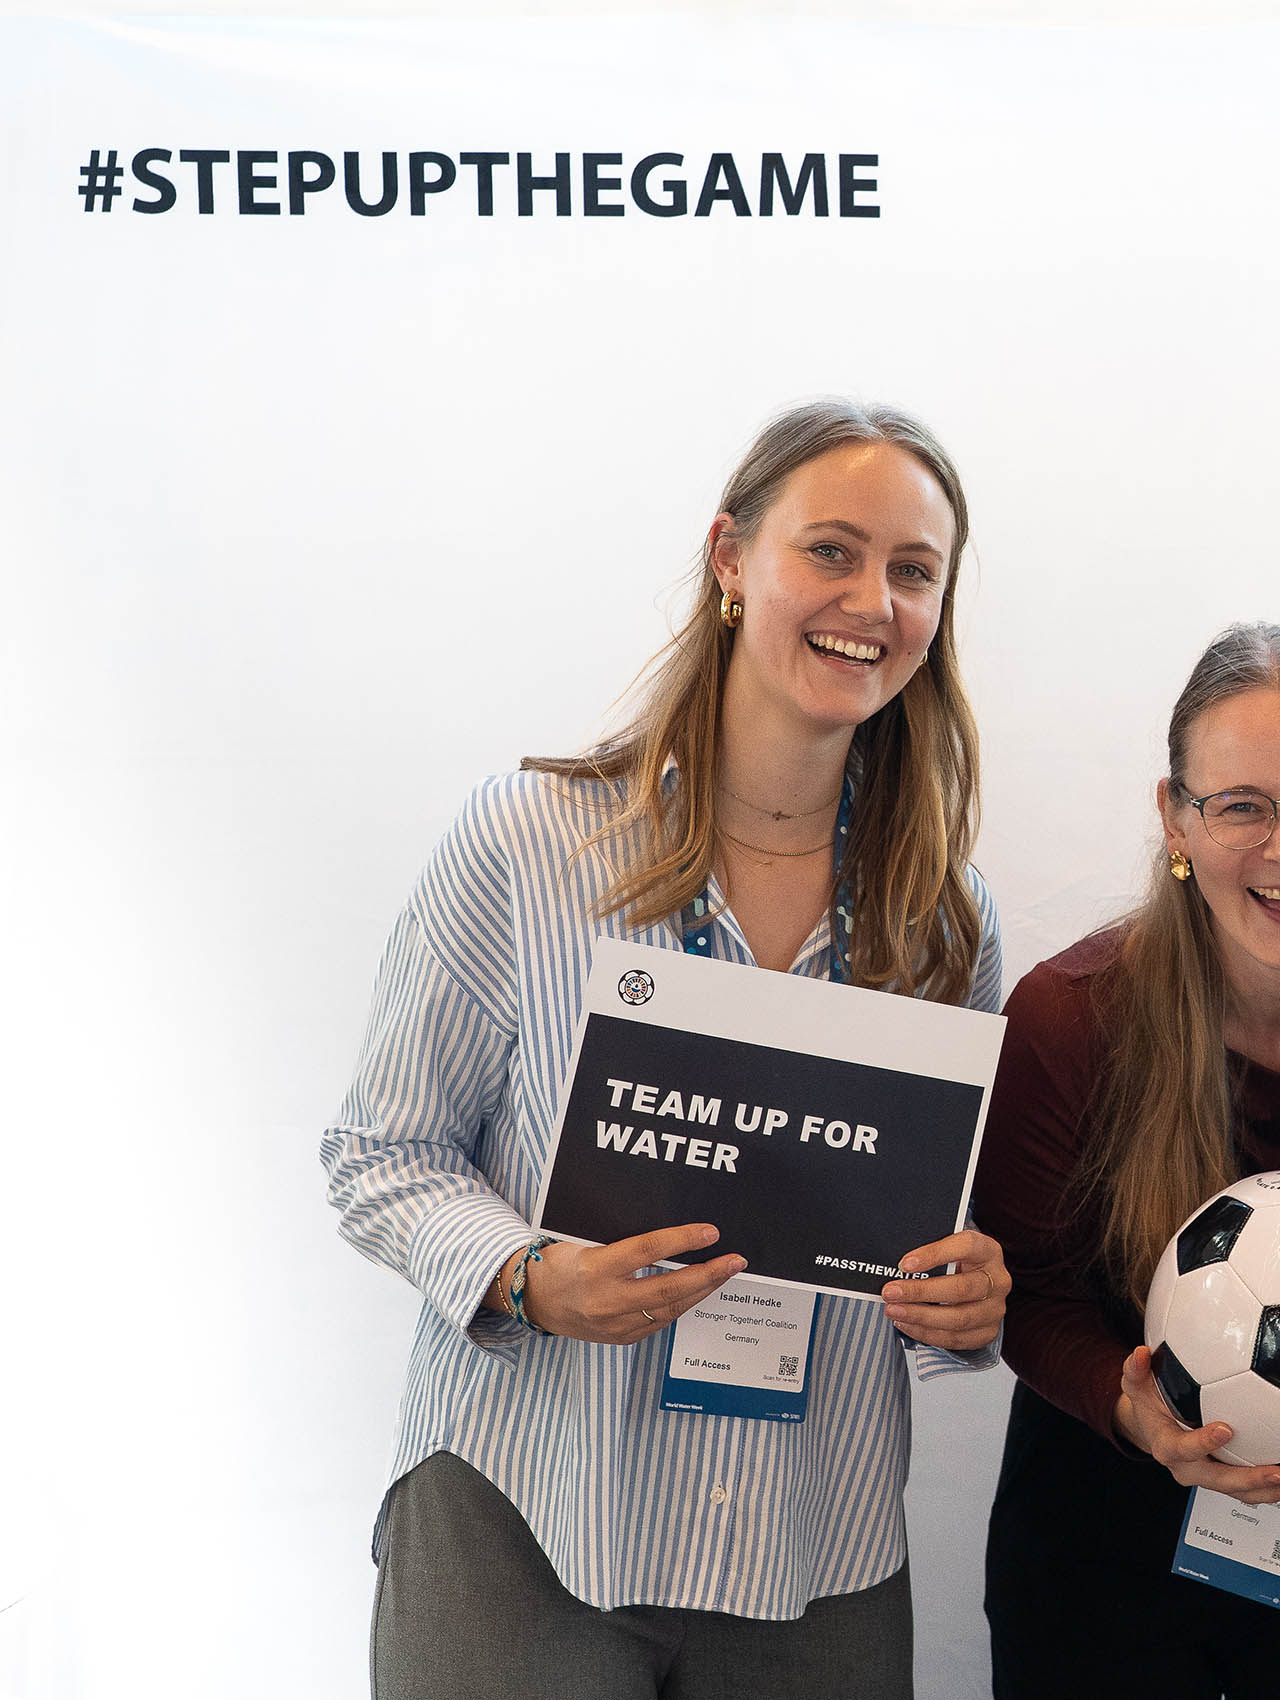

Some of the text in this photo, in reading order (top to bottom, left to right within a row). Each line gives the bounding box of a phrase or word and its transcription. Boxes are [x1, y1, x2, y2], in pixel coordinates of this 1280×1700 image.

[78, 148, 881, 217] #STEPUPTHEGAME
[606, 1078, 879, 1154] TEAM UP FOR
[596, 1120, 740, 1173] WATER
[719, 1292, 782, 1308] Isabell Hedke
[694, 1309, 727, 1321] Stronger
[765, 1318, 798, 1330] Coalition
[724, 1332, 760, 1345] Germany
[684, 1357, 731, 1370] Full Access
[1231, 1509, 1260, 1526] Germany
[1194, 1526, 1233, 1545] Full Access
